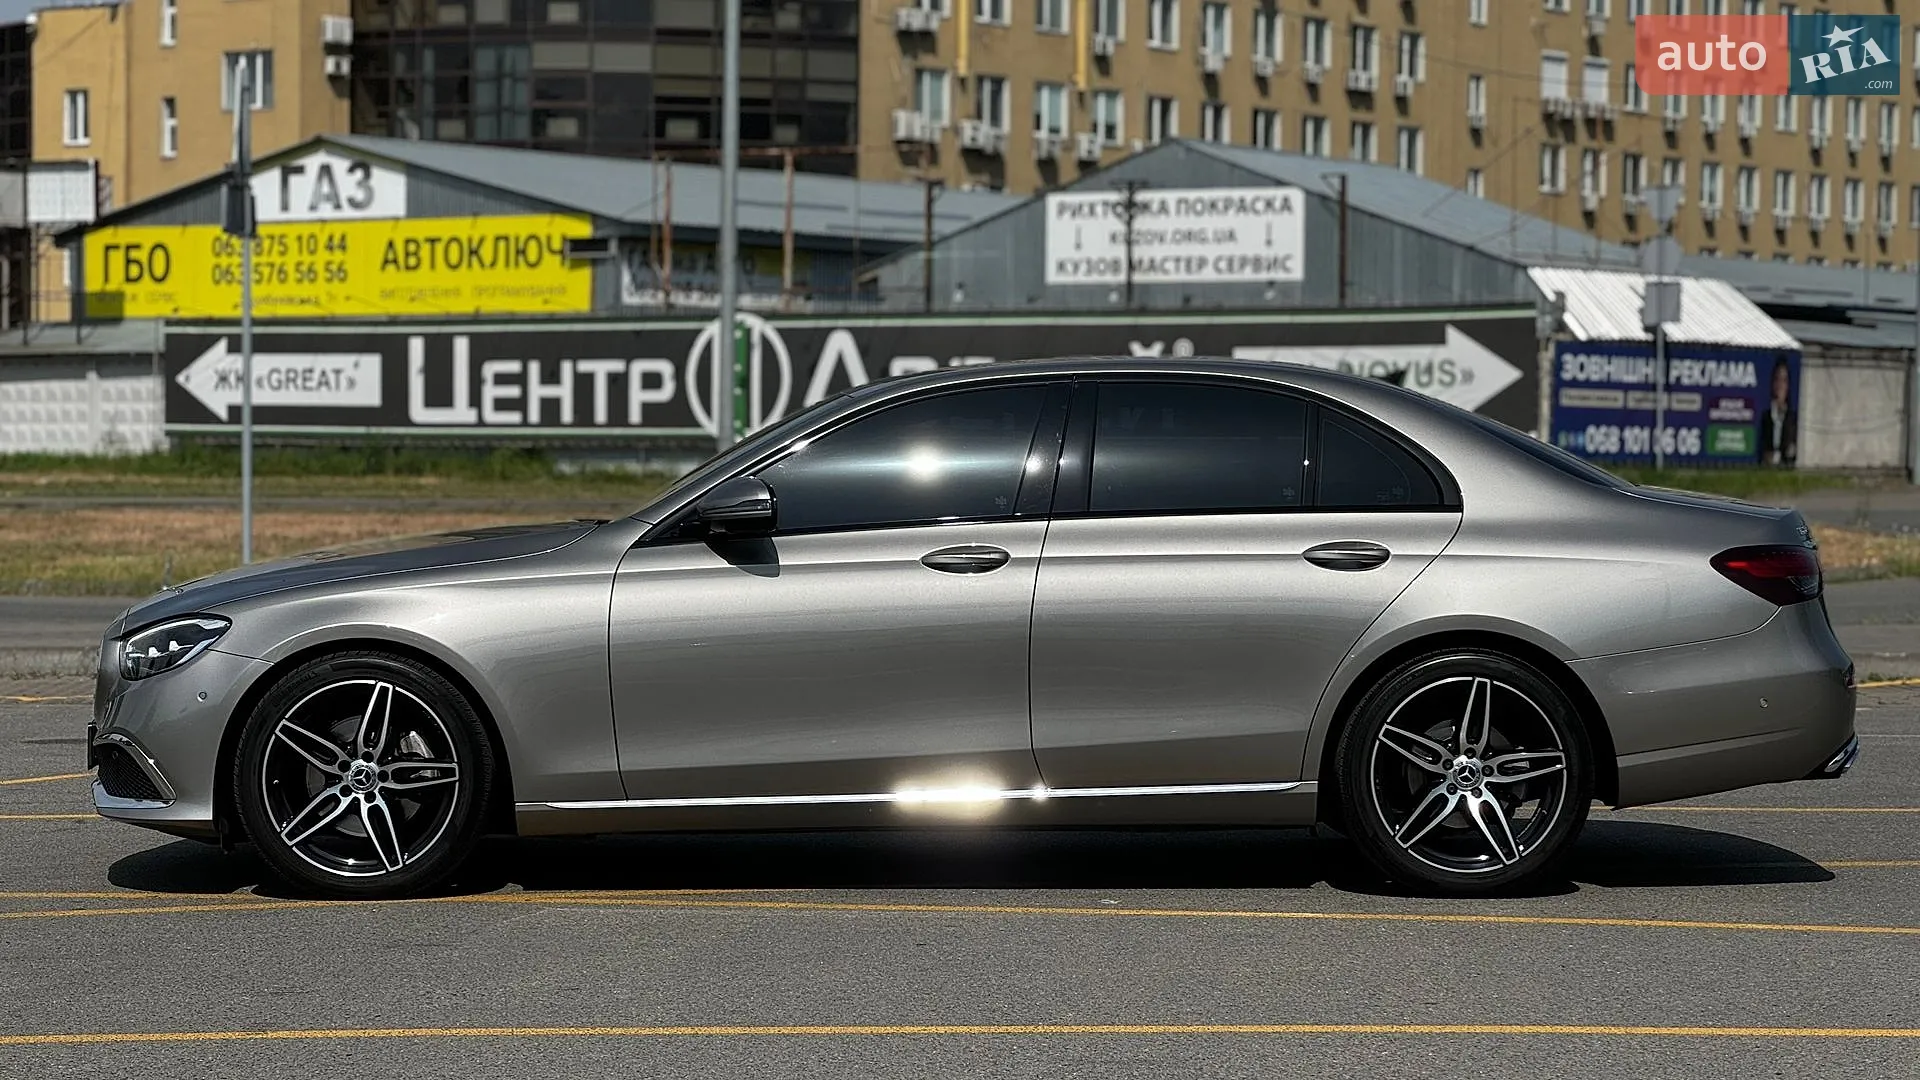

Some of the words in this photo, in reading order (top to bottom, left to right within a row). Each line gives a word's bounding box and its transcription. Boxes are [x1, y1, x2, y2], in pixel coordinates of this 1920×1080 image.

[279, 162, 375, 213] ГАЗ
[1174, 195, 1293, 216] ПОКРАСКА
[211, 235, 246, 258] 06
[252, 233, 289, 257] 875
[296, 232, 318, 256] 10
[325, 233, 348, 254] 44
[381, 234, 566, 272] АВТОКЛЮЧ
[103, 243, 169, 285] ГБО
[253, 261, 289, 285] 576
[295, 260, 318, 284] 56
[324, 259, 348, 283] 56
[1056, 257, 1122, 277] КУЗОВ
[1212, 253, 1294, 275] СЕРВИС
[256, 367, 357, 392] «GREAT»
[1561, 352, 1665, 385] ЗОВНІШН
[1669, 357, 1757, 387] РЕКЛАМА
[1622, 425, 1651, 455] 101
[1677, 427, 1701, 456] 06
